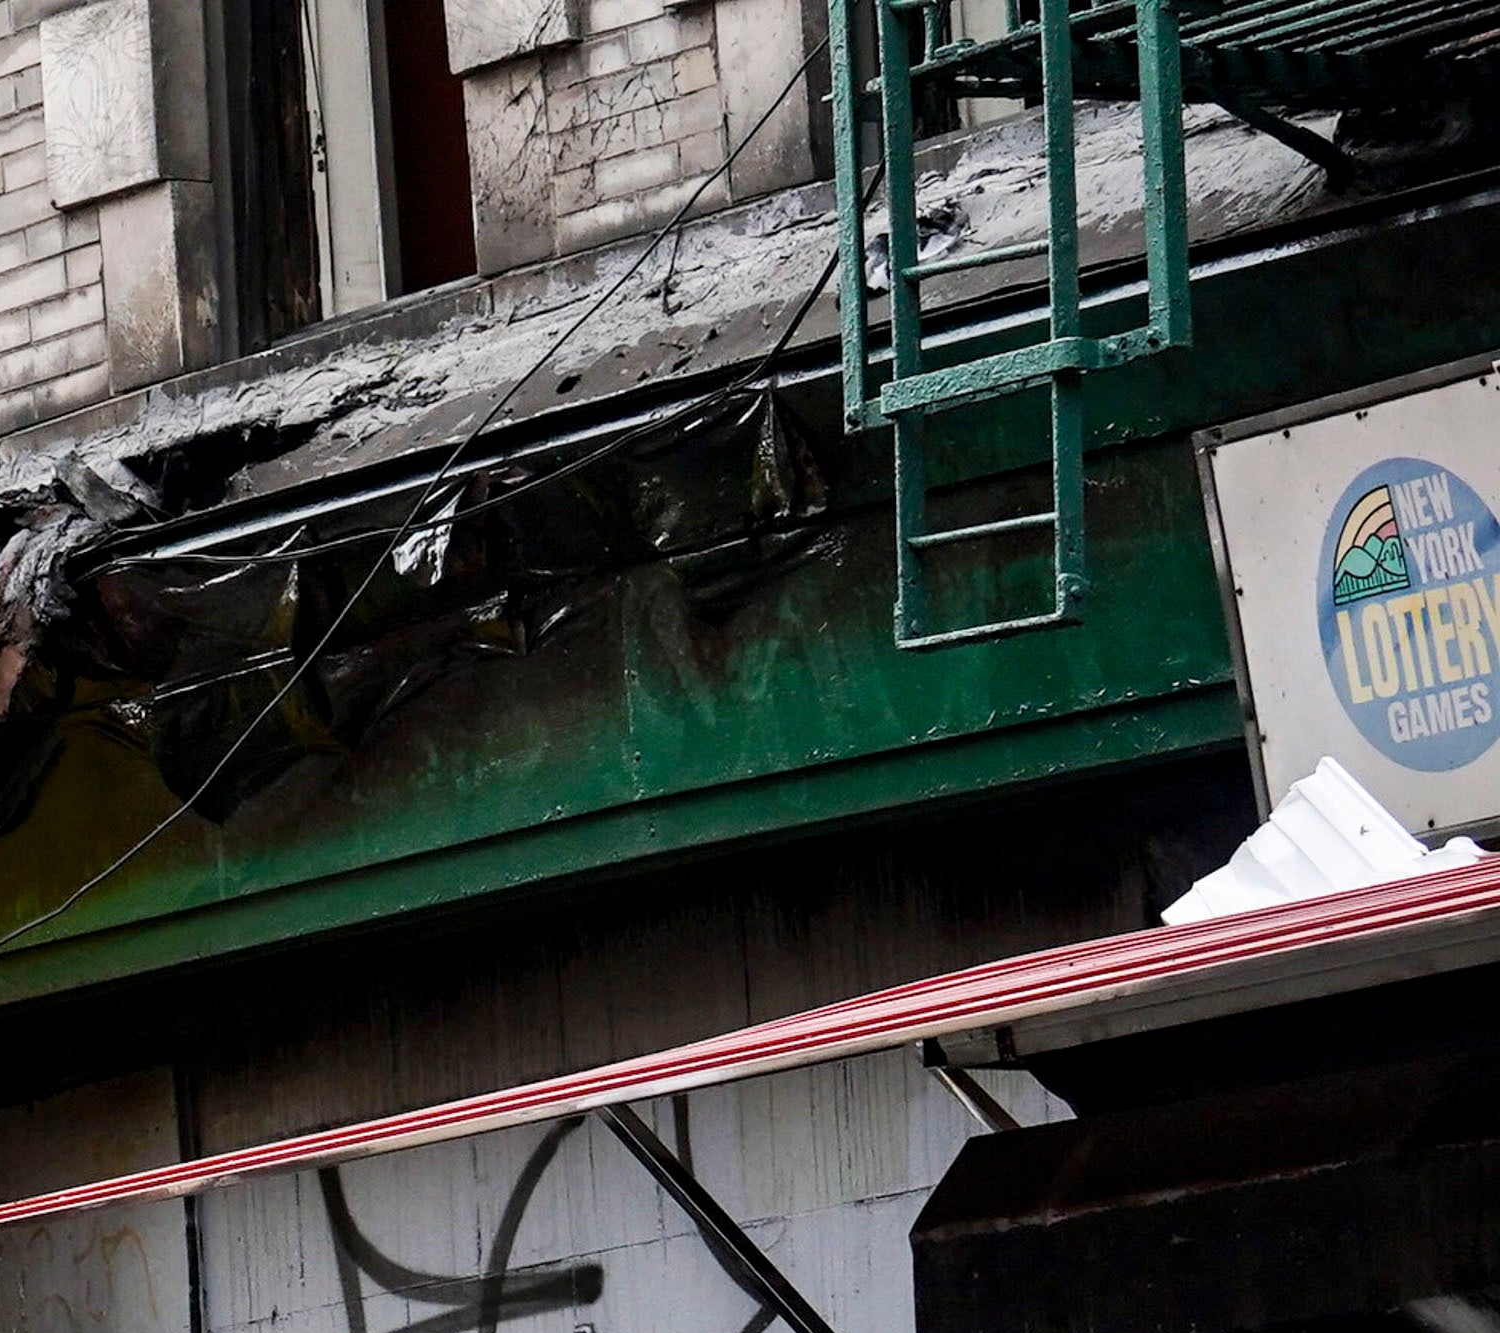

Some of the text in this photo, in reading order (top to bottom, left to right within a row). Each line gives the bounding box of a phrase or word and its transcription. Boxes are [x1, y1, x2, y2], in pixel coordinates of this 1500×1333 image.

[1391, 472, 1455, 530] NEW
[1405, 521, 1485, 584] YORK
[1387, 682, 1492, 744] GAMES
